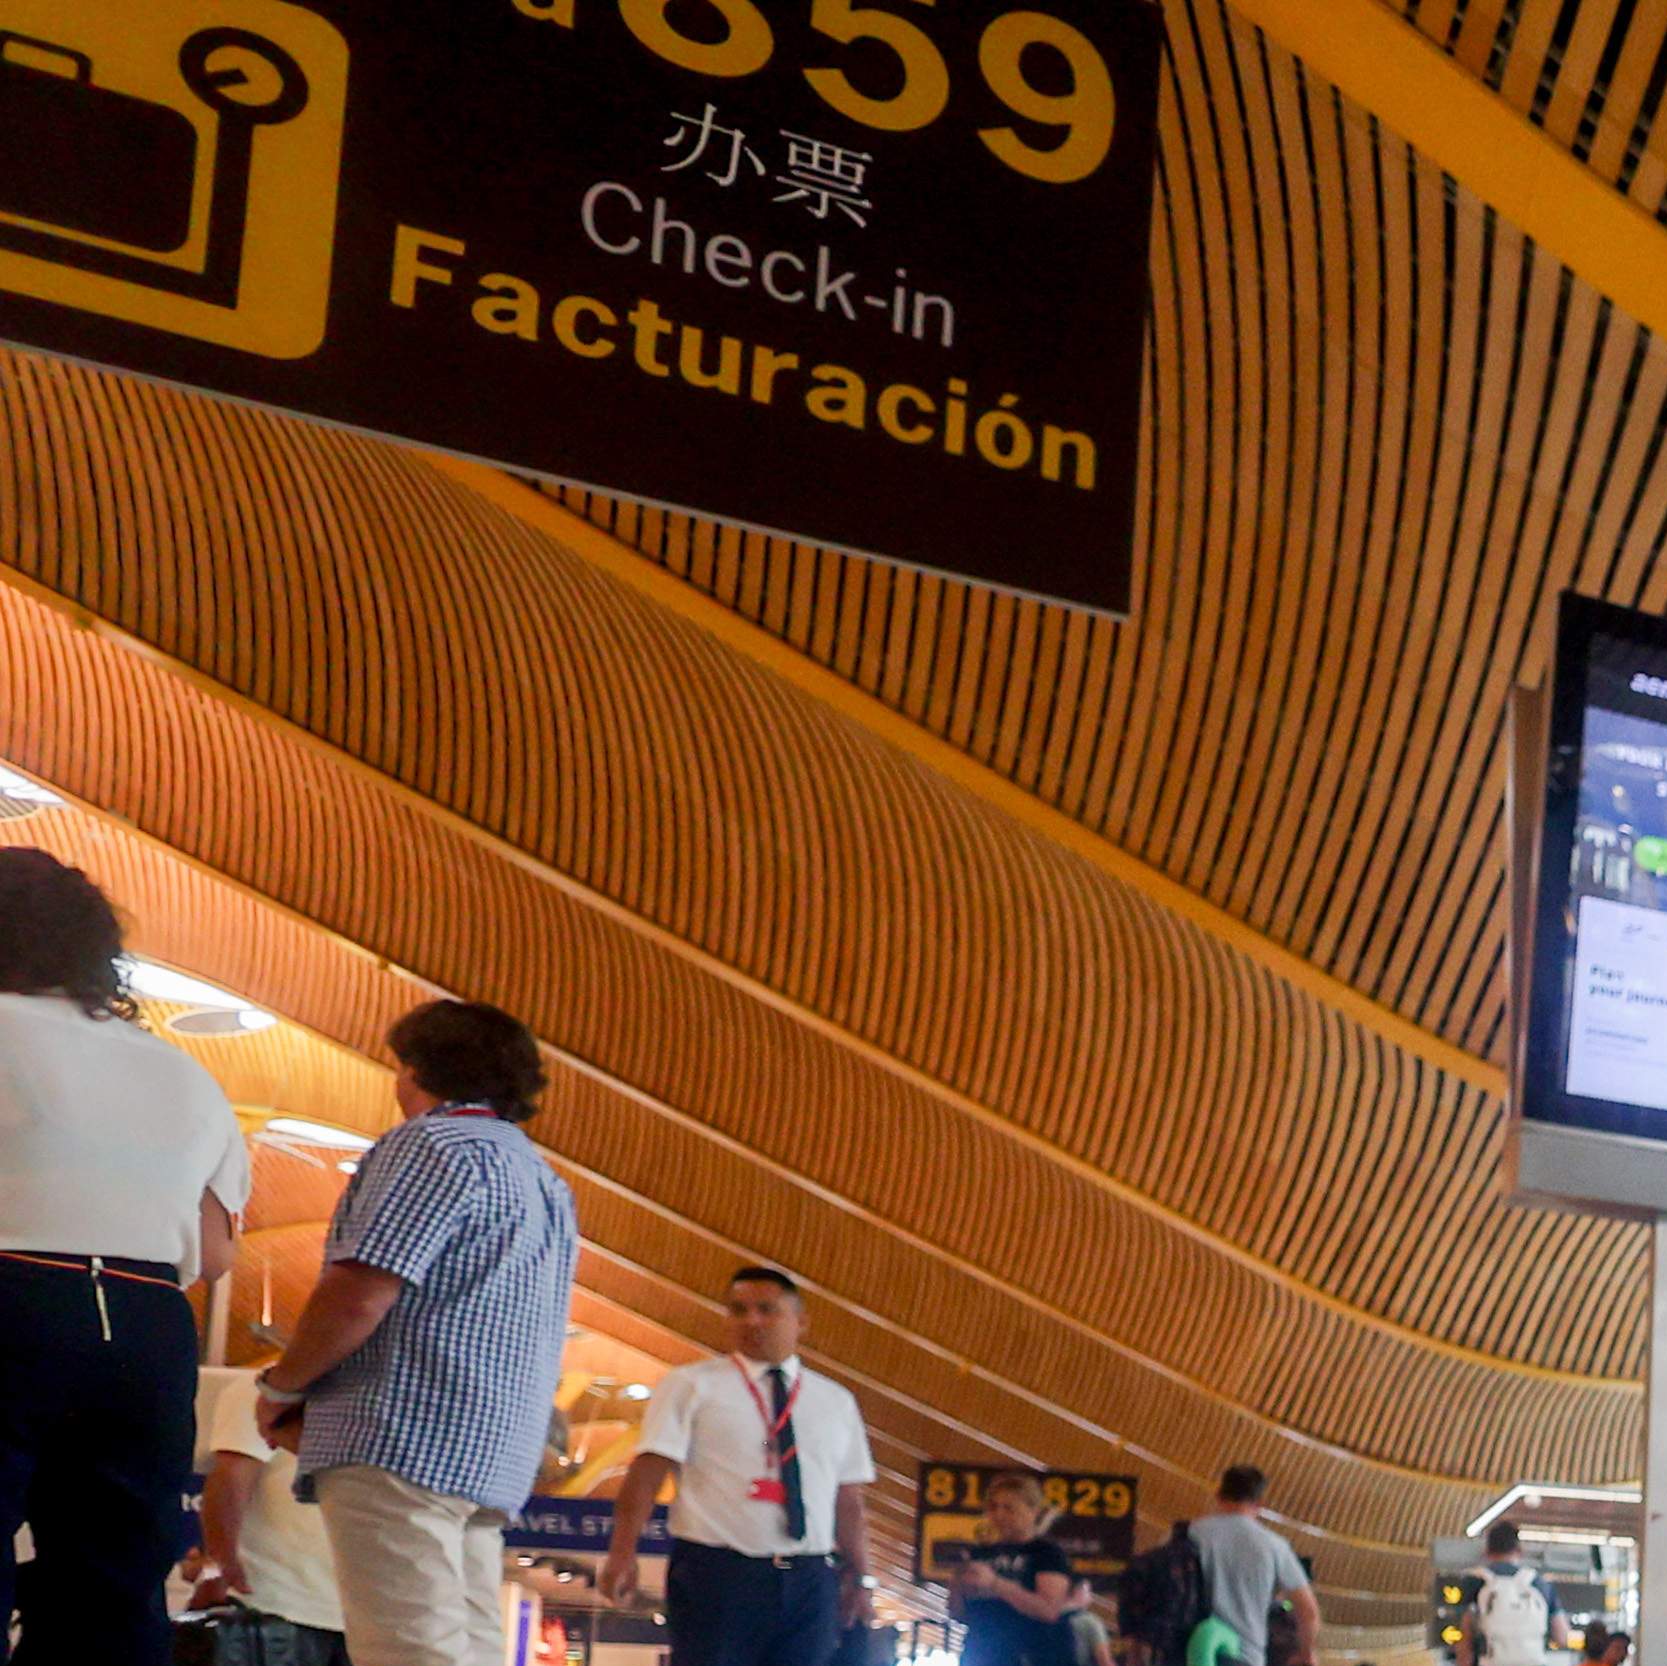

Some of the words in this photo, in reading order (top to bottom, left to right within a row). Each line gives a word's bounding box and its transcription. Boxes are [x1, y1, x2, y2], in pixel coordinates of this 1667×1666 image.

[660, 102, 874, 228] 办票
[580, 182, 957, 348] Check-in
[389, 224, 1097, 491] Facturación
